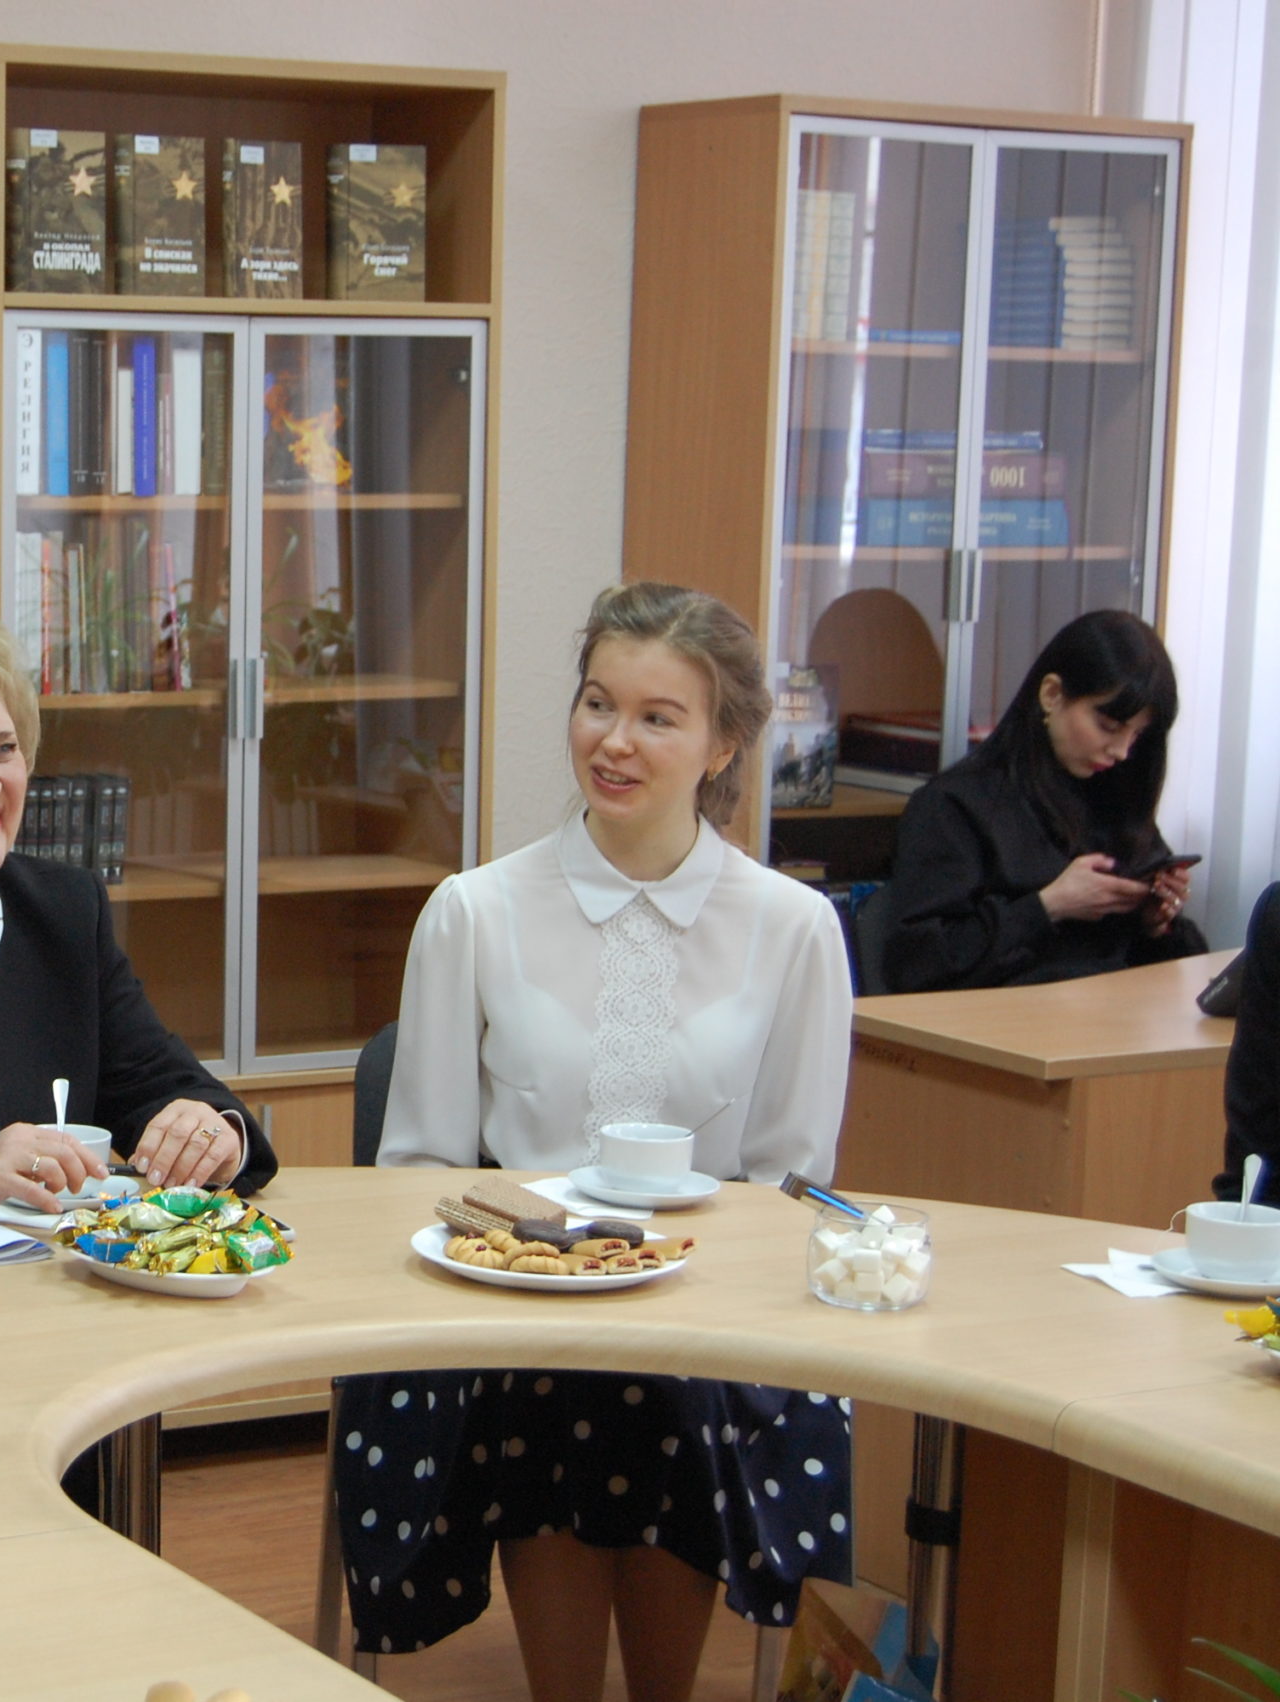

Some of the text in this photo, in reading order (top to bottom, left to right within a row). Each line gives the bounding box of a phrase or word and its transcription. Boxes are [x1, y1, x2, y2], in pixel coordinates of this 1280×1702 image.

[33, 250, 101, 275] СТАЛИНГРАДА
[240, 257, 249, 269] А
[363, 253, 409, 267] Горячий
[139, 262, 152, 273] не
[989, 466, 1027, 489] 1000
